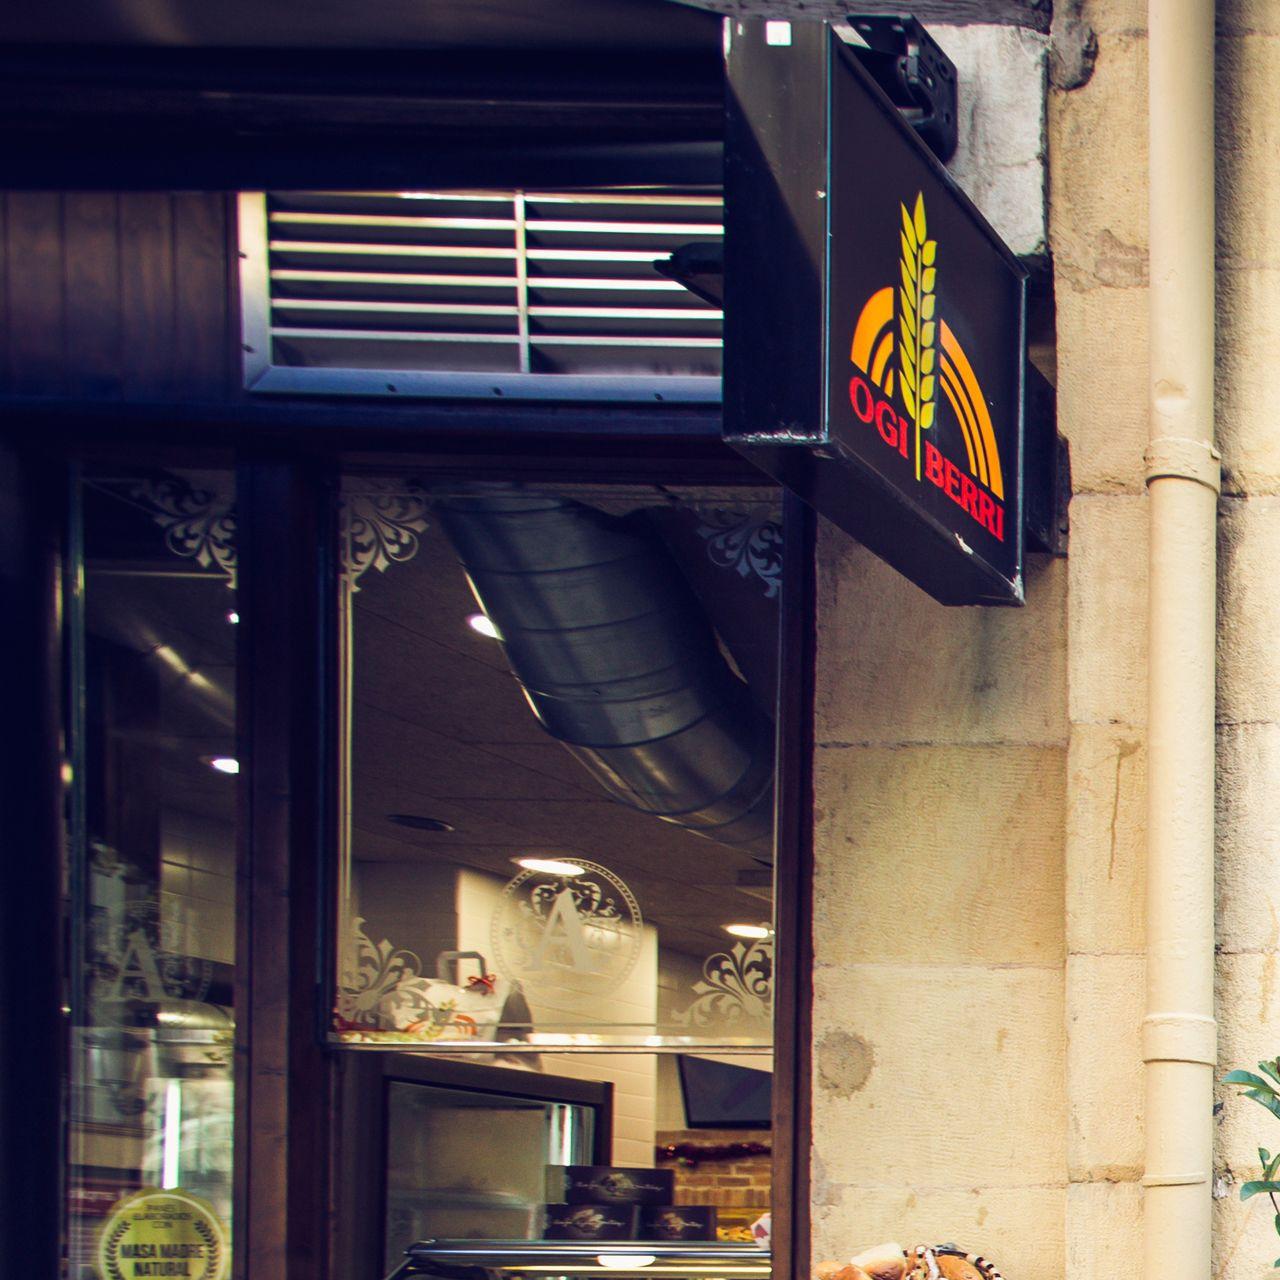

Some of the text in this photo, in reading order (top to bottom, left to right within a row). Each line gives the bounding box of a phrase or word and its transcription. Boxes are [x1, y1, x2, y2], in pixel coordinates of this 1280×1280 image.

[849, 375, 1005, 543] OGI BERRI
[120, 1243, 205, 1259] MASA MADRE
[133, 1261, 192, 1277] NATURAL
